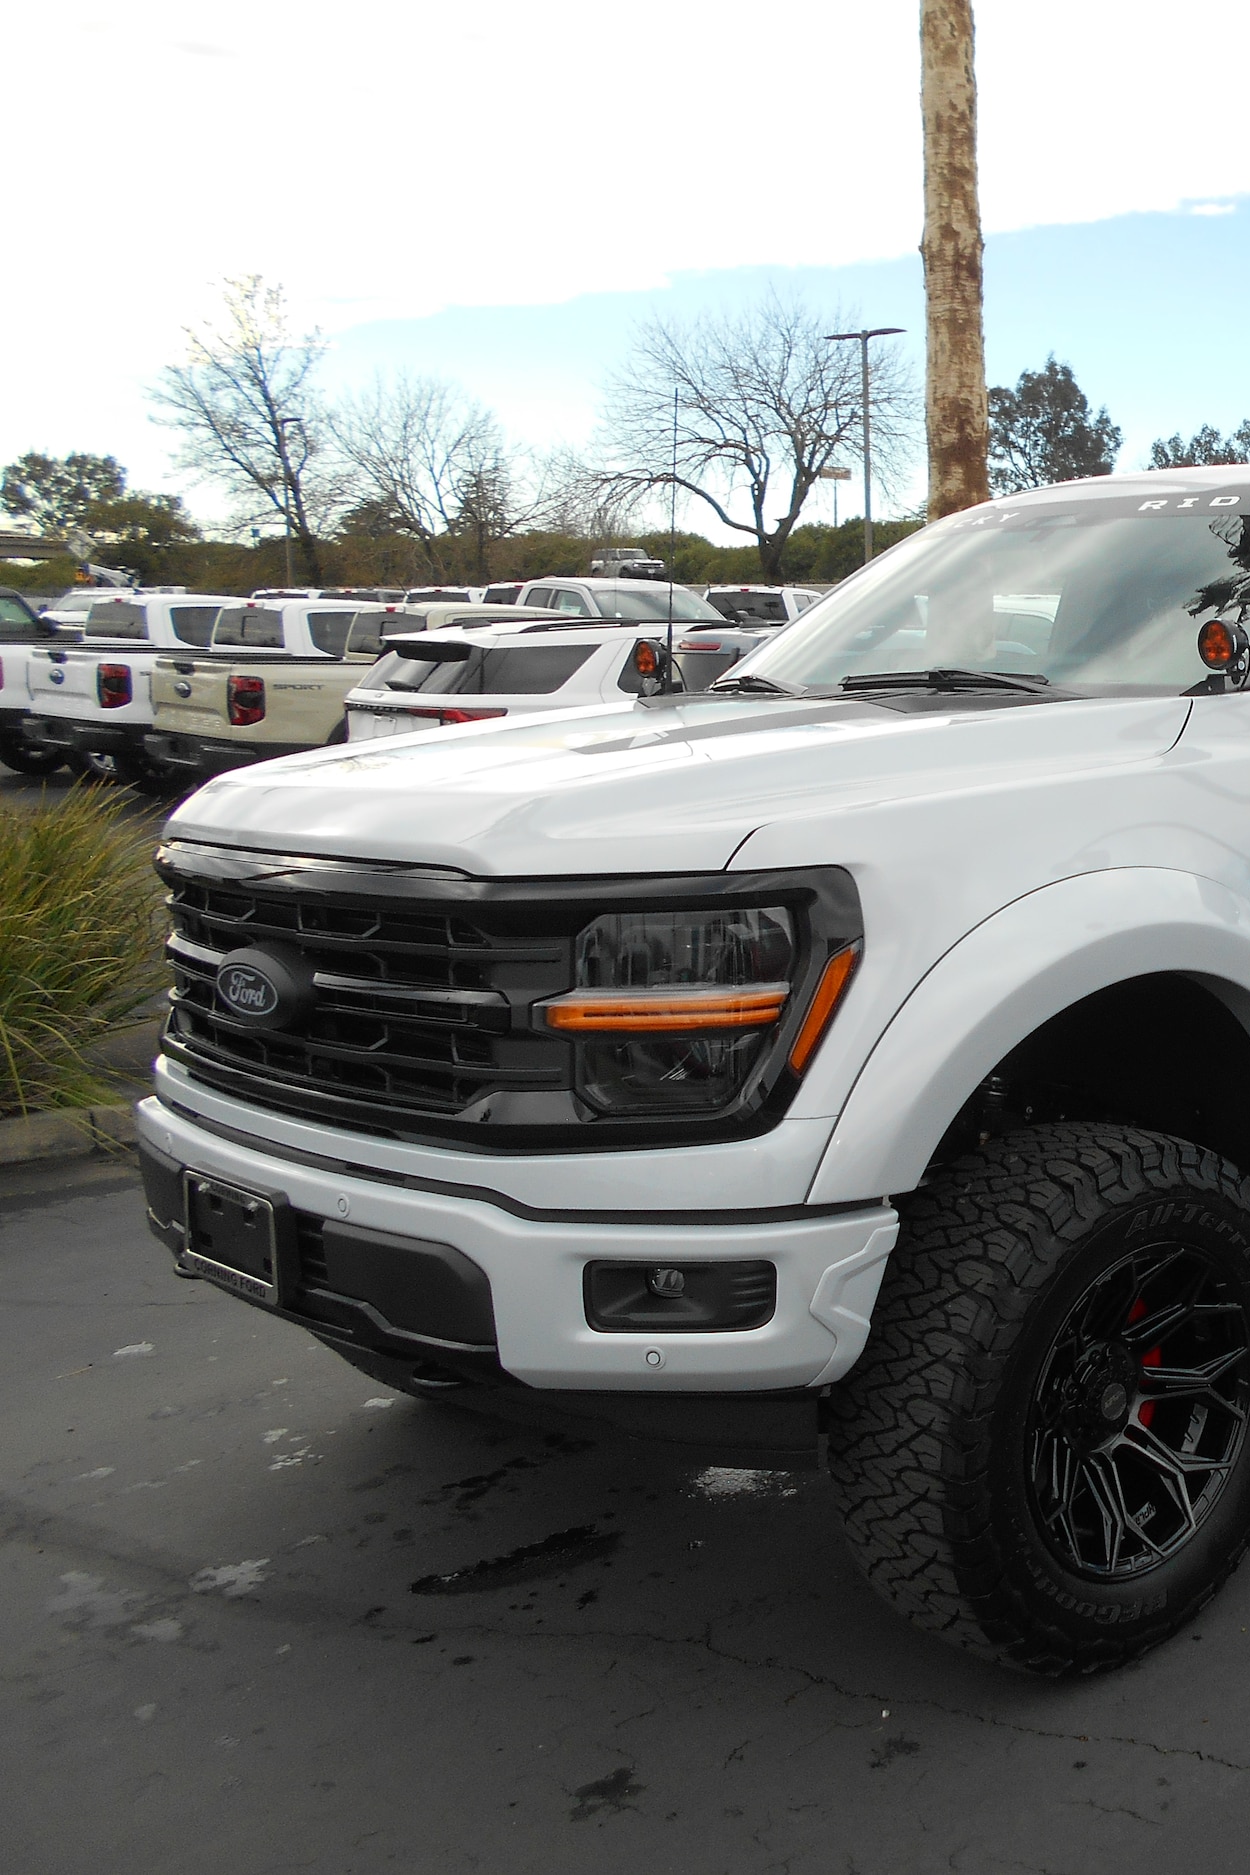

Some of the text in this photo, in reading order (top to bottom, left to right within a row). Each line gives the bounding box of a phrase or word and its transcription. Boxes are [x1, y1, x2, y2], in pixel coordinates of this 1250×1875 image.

[272, 683, 326, 691] SPORT
[229, 970, 266, 1007] Ford
[194, 1258, 266, 1299] CORNING FORD
[1012, 1517, 1168, 1625] BFGoodr
